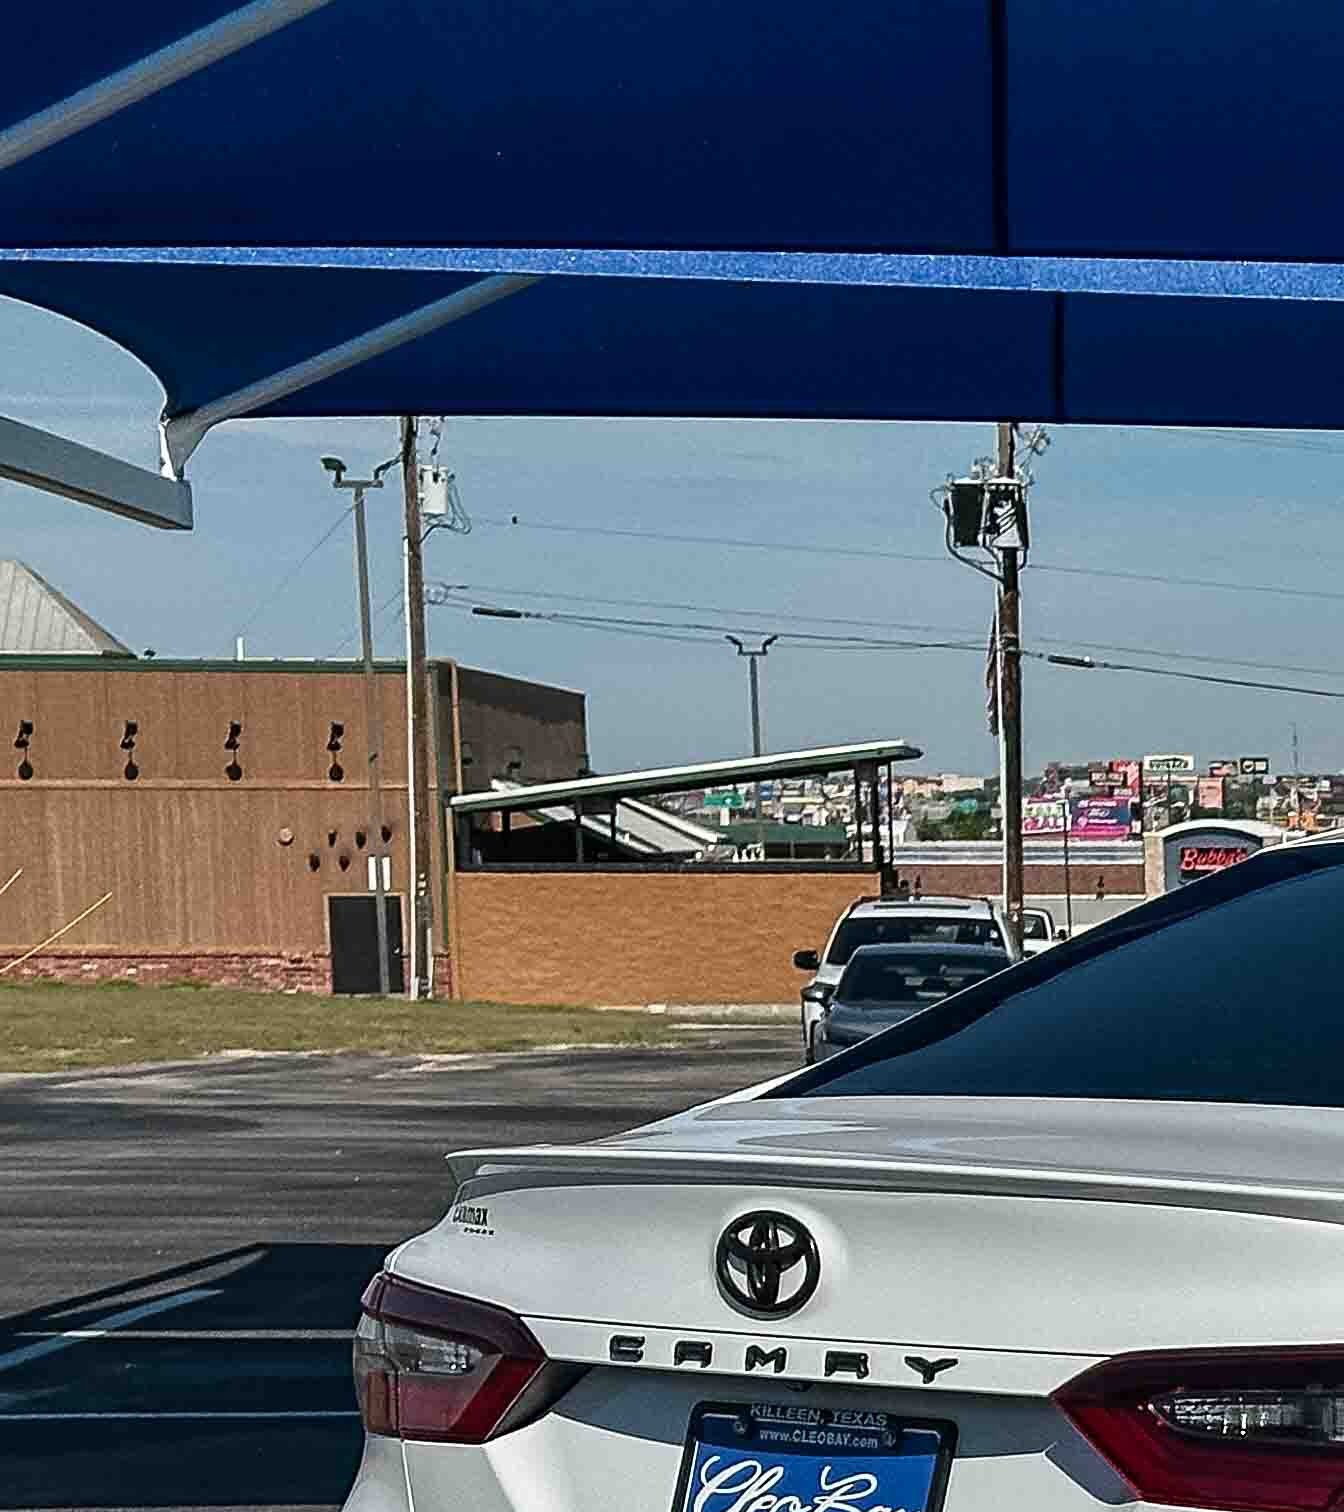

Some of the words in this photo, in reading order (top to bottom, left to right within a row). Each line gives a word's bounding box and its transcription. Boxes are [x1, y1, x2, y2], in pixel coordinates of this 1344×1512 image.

[608, 1334, 960, 1385] CAMRY
[750, 1402, 825, 1425] KILLEEN,
[832, 1408, 889, 1428] TEXAS
[759, 1428, 879, 1449] www.CLEOBAY.com
